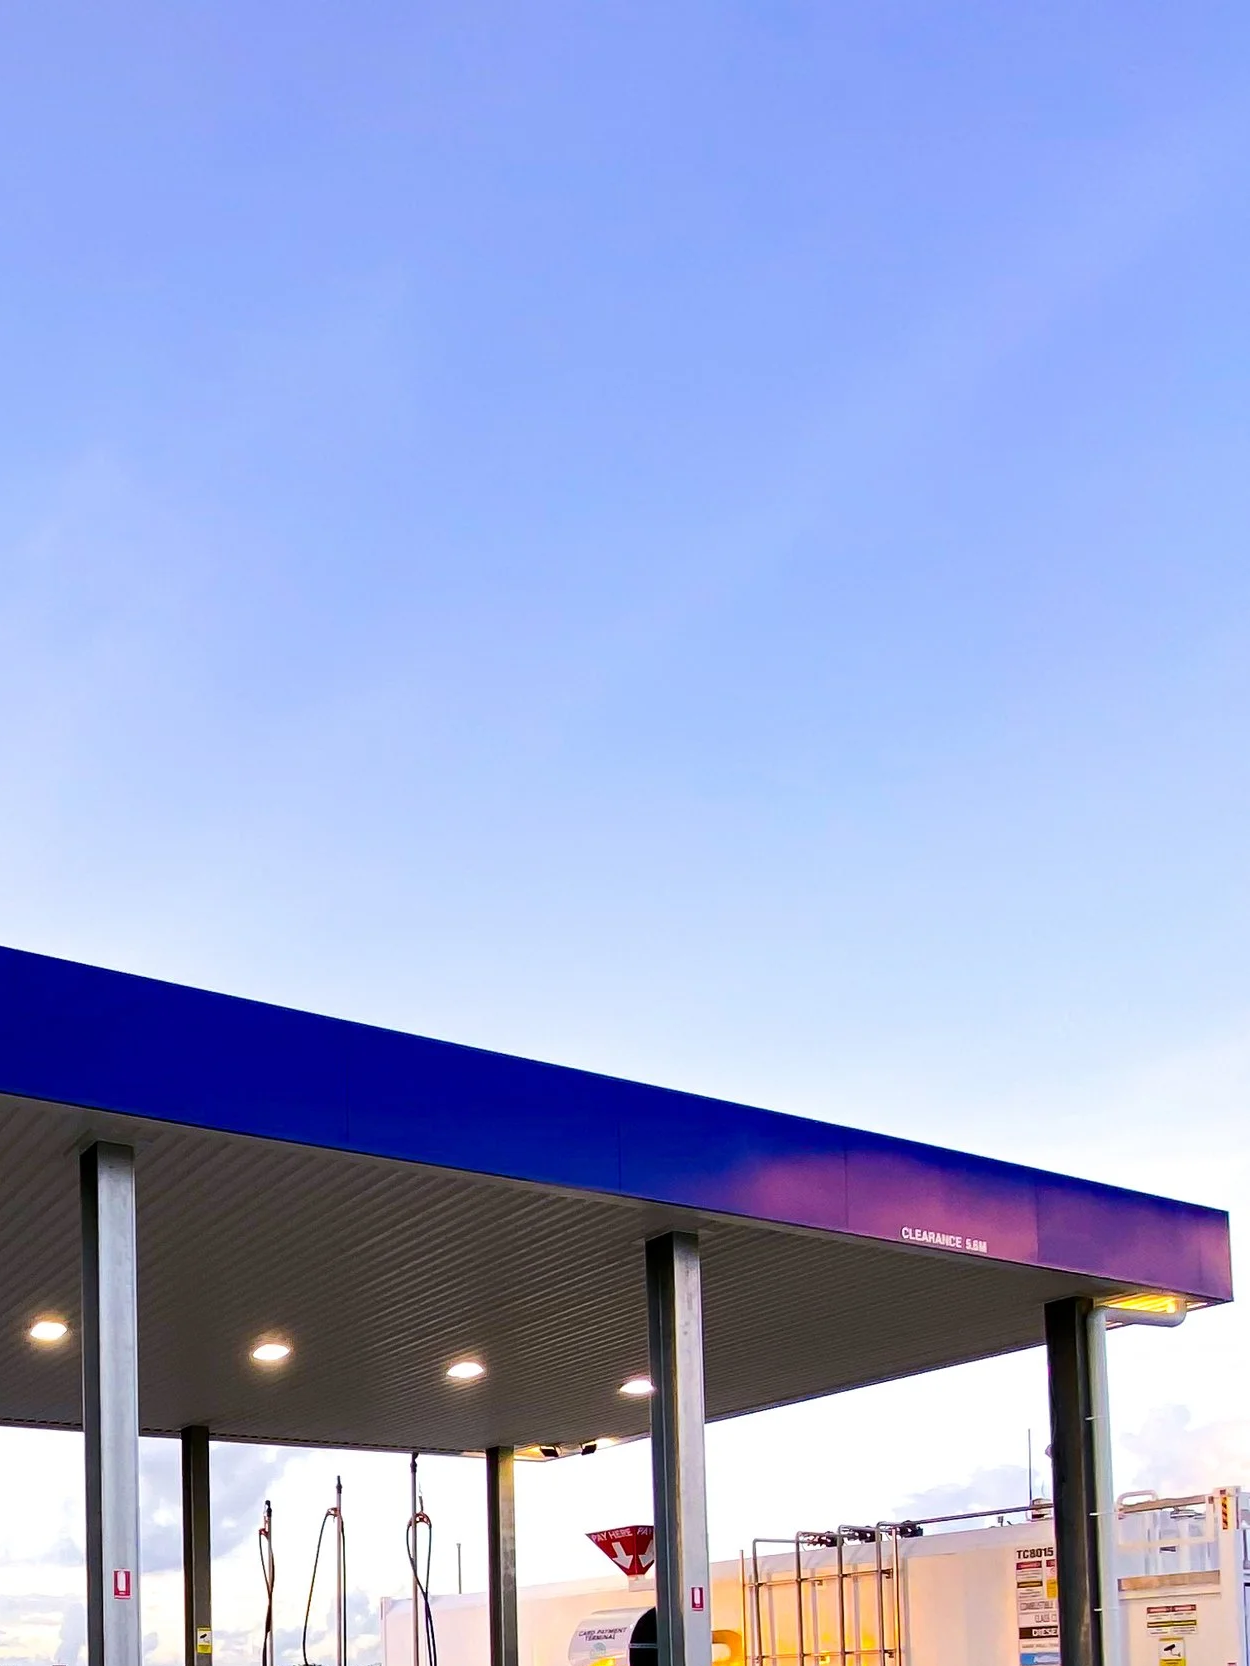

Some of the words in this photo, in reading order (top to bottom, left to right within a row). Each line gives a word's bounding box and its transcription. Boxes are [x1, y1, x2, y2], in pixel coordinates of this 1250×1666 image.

[901, 1226, 963, 1249] CLEARANCE
[965, 1238, 988, 1254] 5.6M
[591, 1532, 608, 1542] PAY
[608, 1528, 633, 1540] HERE
[1016, 1546, 1054, 1560] TC8015
[596, 1626, 628, 1635] PAYMENT
[1031, 1628, 1058, 1637] DIESE
[585, 1634, 616, 1642] TERMINAL
